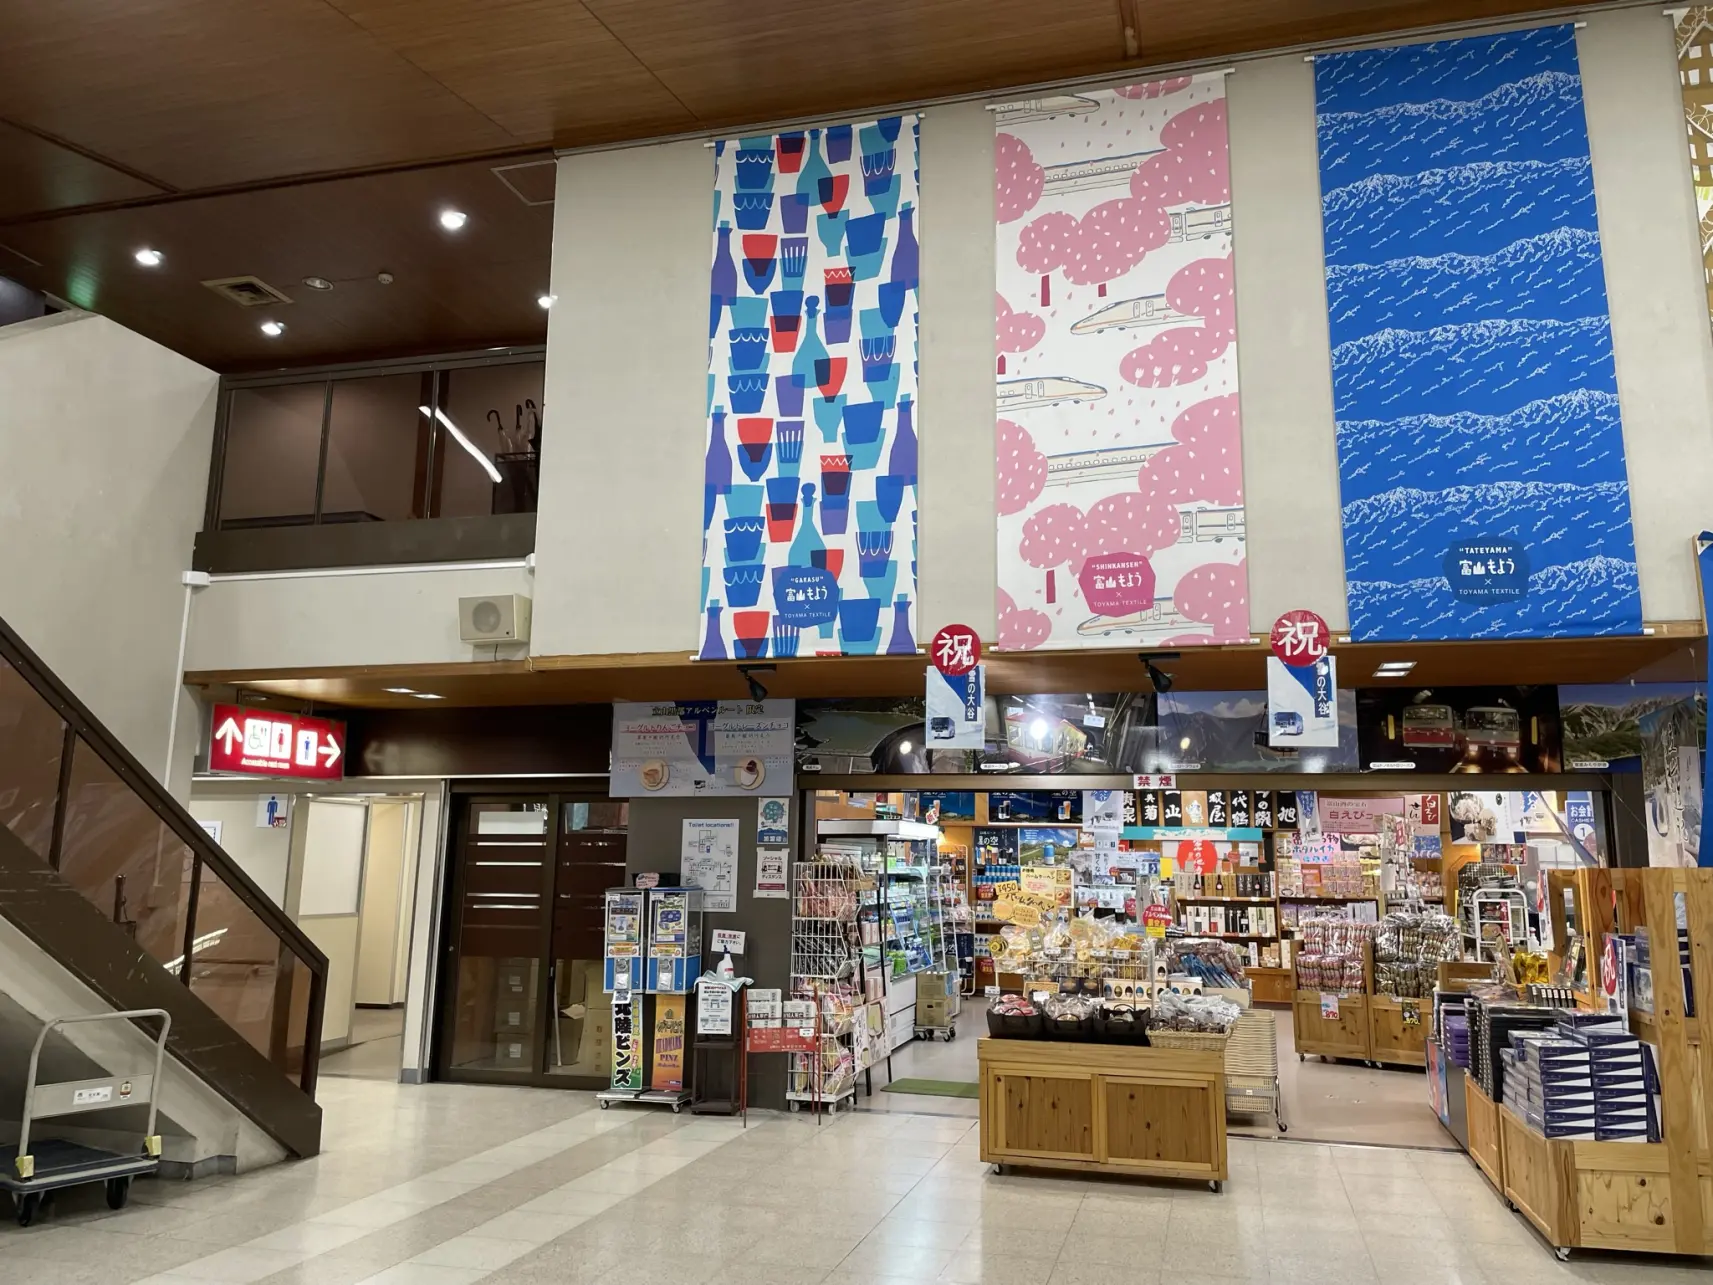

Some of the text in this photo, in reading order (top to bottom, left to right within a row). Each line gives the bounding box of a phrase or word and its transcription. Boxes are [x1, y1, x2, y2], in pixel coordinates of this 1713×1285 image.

[1459, 558, 1515, 575] 富山もよう
[1093, 572, 1142, 589] 富山もよう
[785, 586, 828, 602] 富山もよう
[1278, 619, 1324, 656] 祝
[936, 632, 975, 666] 祝
[1138, 776, 1172, 786] 禁煙
[615, 1002, 632, 1085] 北陸ピンズ
